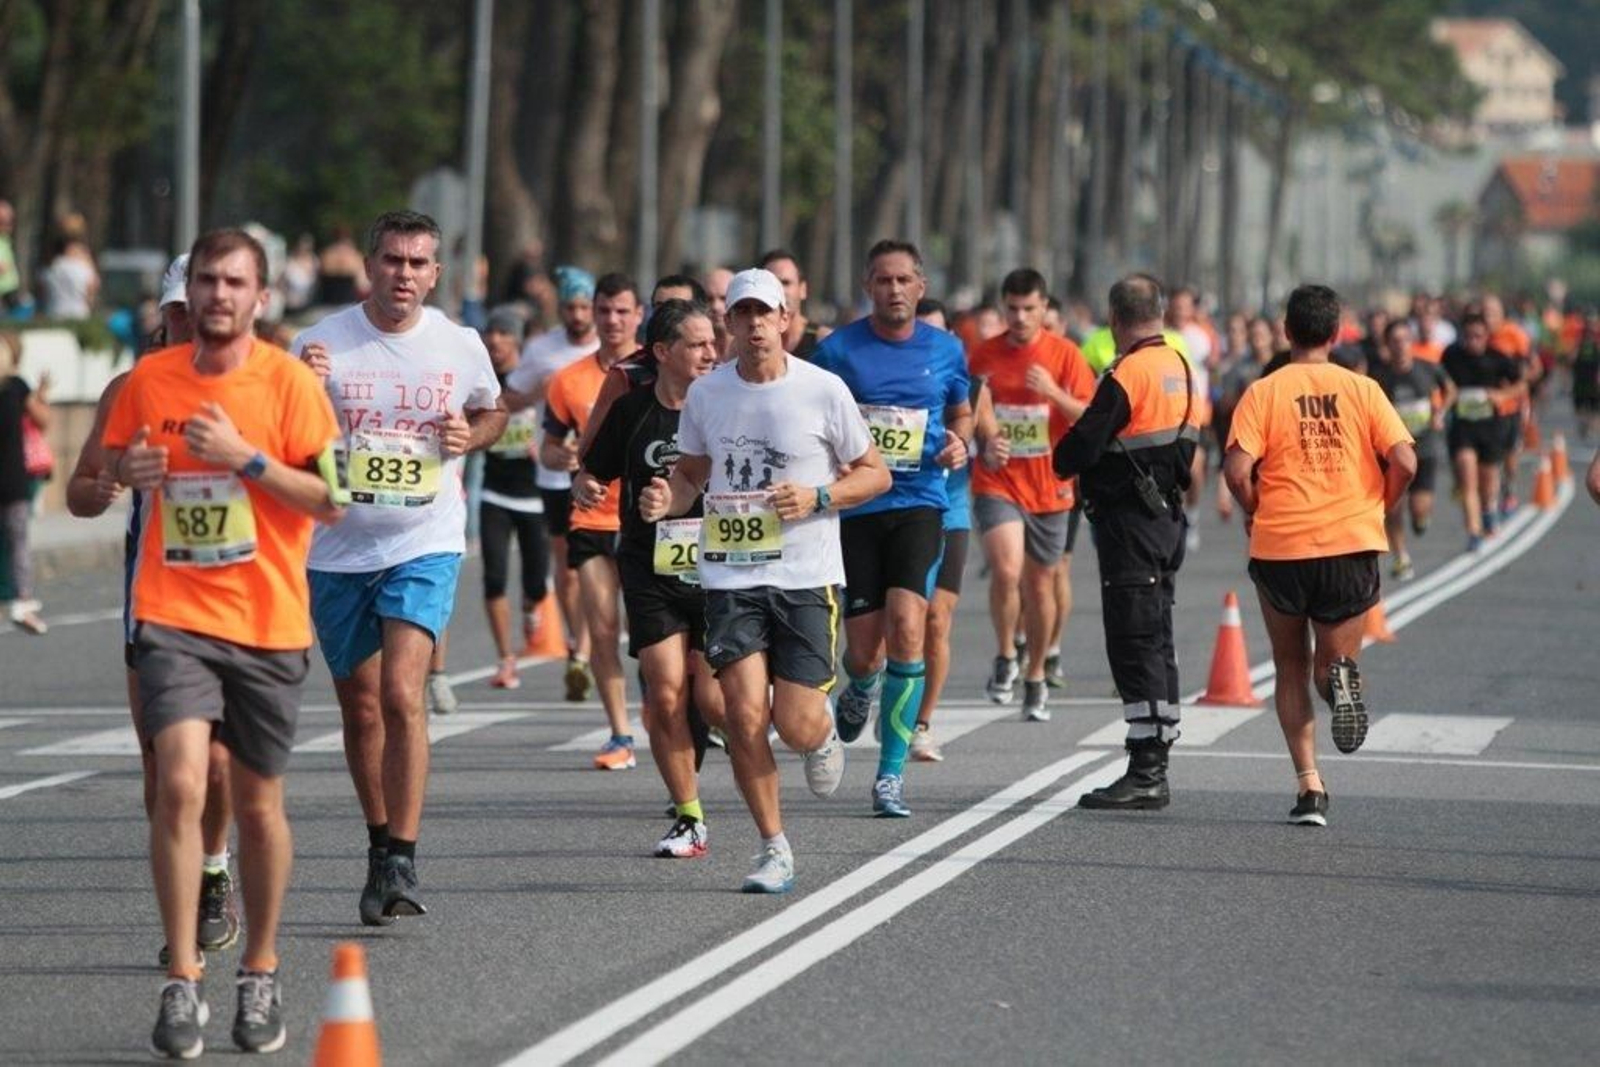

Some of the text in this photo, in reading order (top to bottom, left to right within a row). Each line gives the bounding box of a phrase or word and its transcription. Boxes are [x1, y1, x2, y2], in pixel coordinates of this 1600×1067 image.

[394, 384, 453, 419] 10K
[1294, 393, 1340, 419] 10K
[1300, 421, 1342, 436] PRAIA
[366, 456, 422, 485] 833
[174, 505, 229, 538] 687
[719, 517, 764, 543] 998
